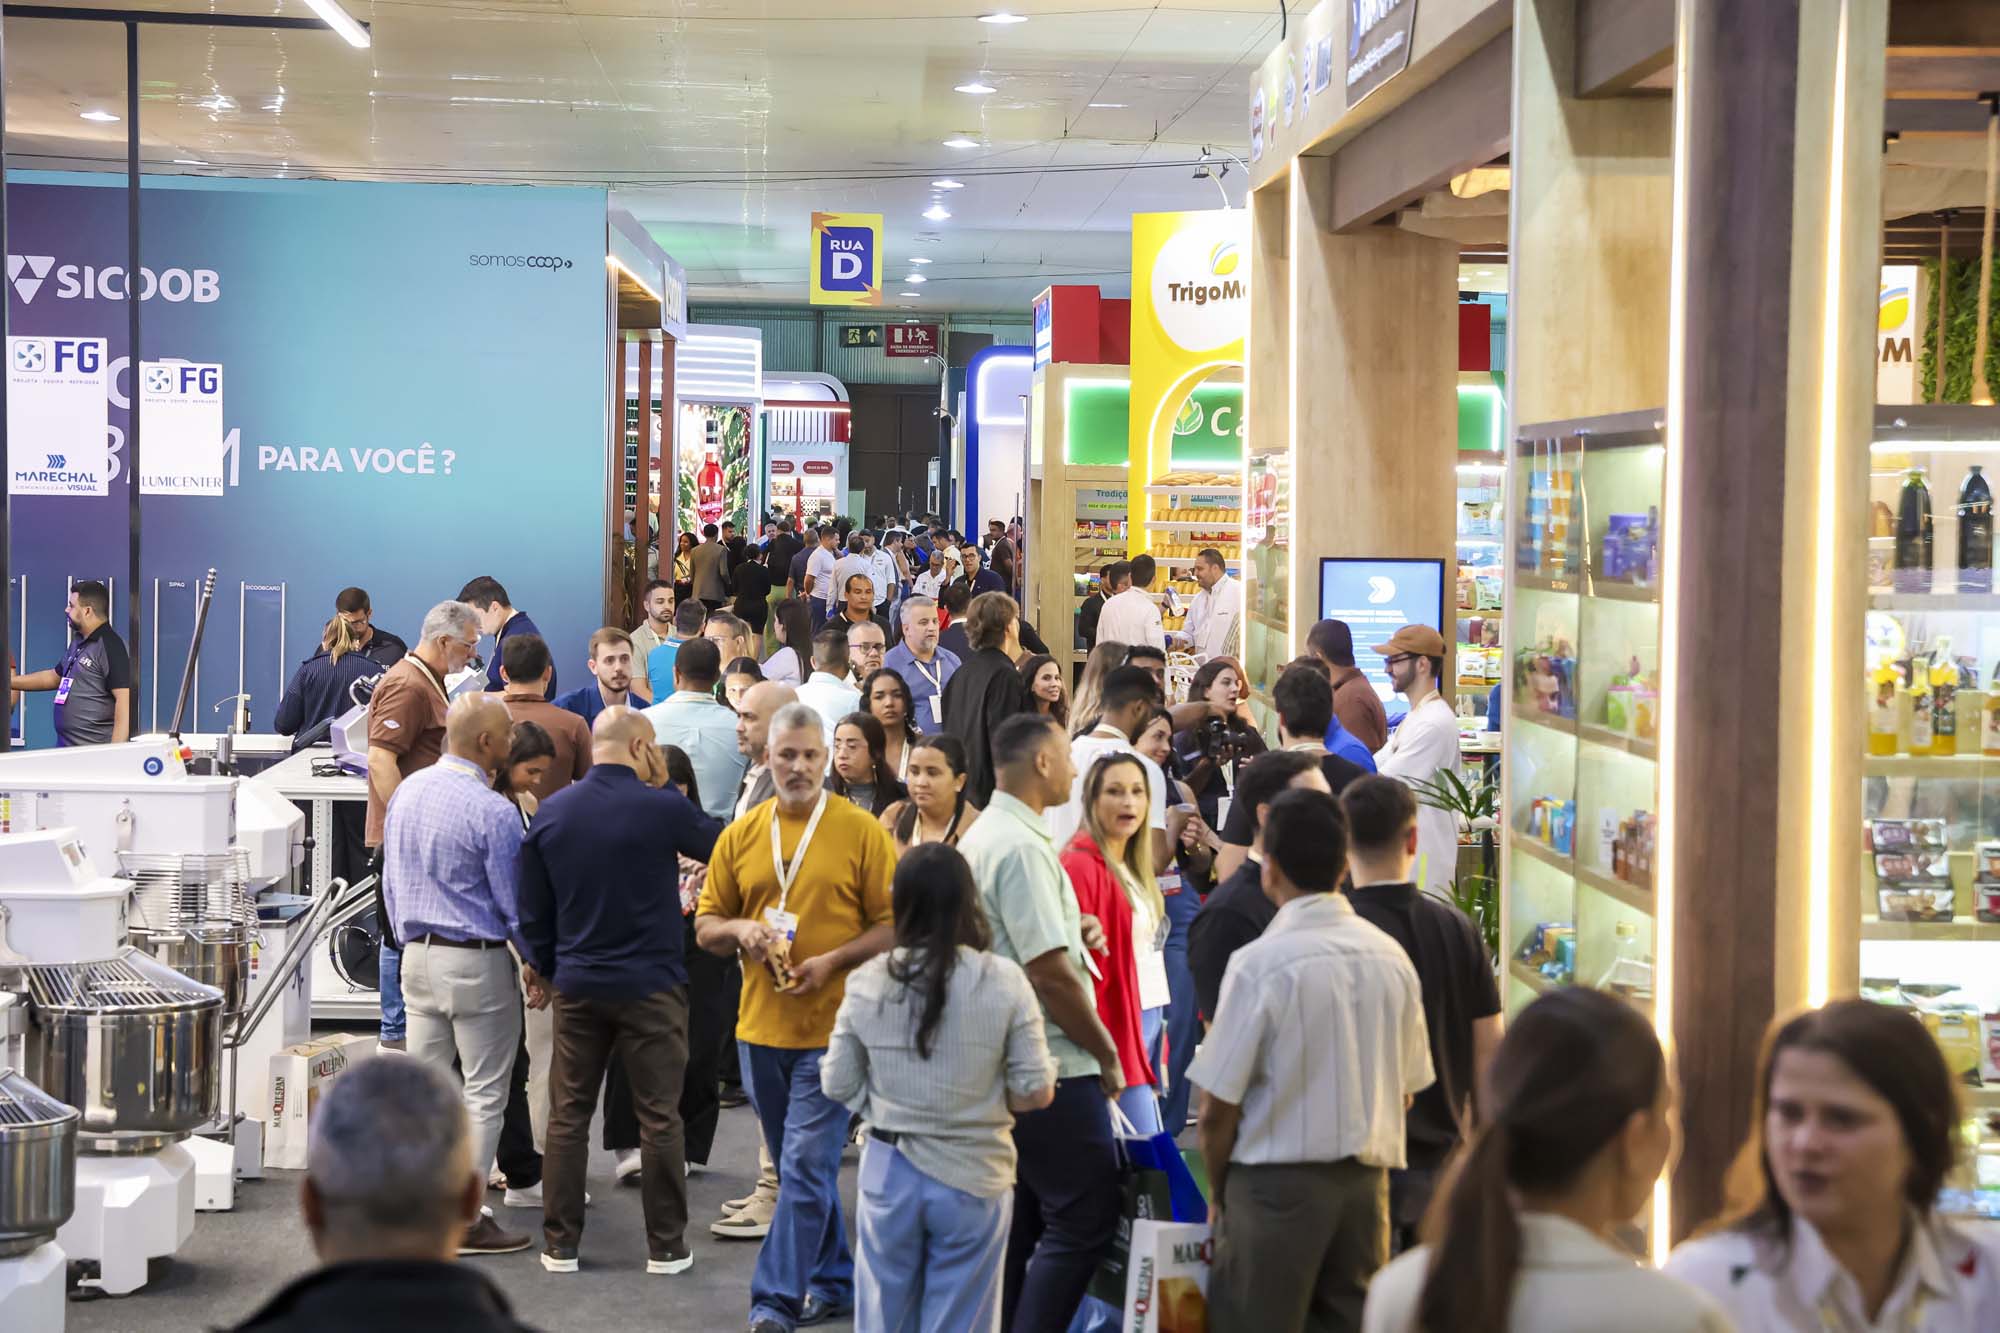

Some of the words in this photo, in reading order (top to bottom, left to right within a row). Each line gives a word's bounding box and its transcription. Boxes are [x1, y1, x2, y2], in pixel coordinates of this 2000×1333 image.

[830, 239, 865, 251] RUA
[832, 252, 863, 280] D
[56, 264, 221, 303] SICOOB
[54, 341, 99, 374] FG
[180, 367, 218, 394] FG
[258, 445, 344, 473] PARA
[15, 471, 97, 483] MARECHAL
[142, 475, 222, 488] LUMICENTER
